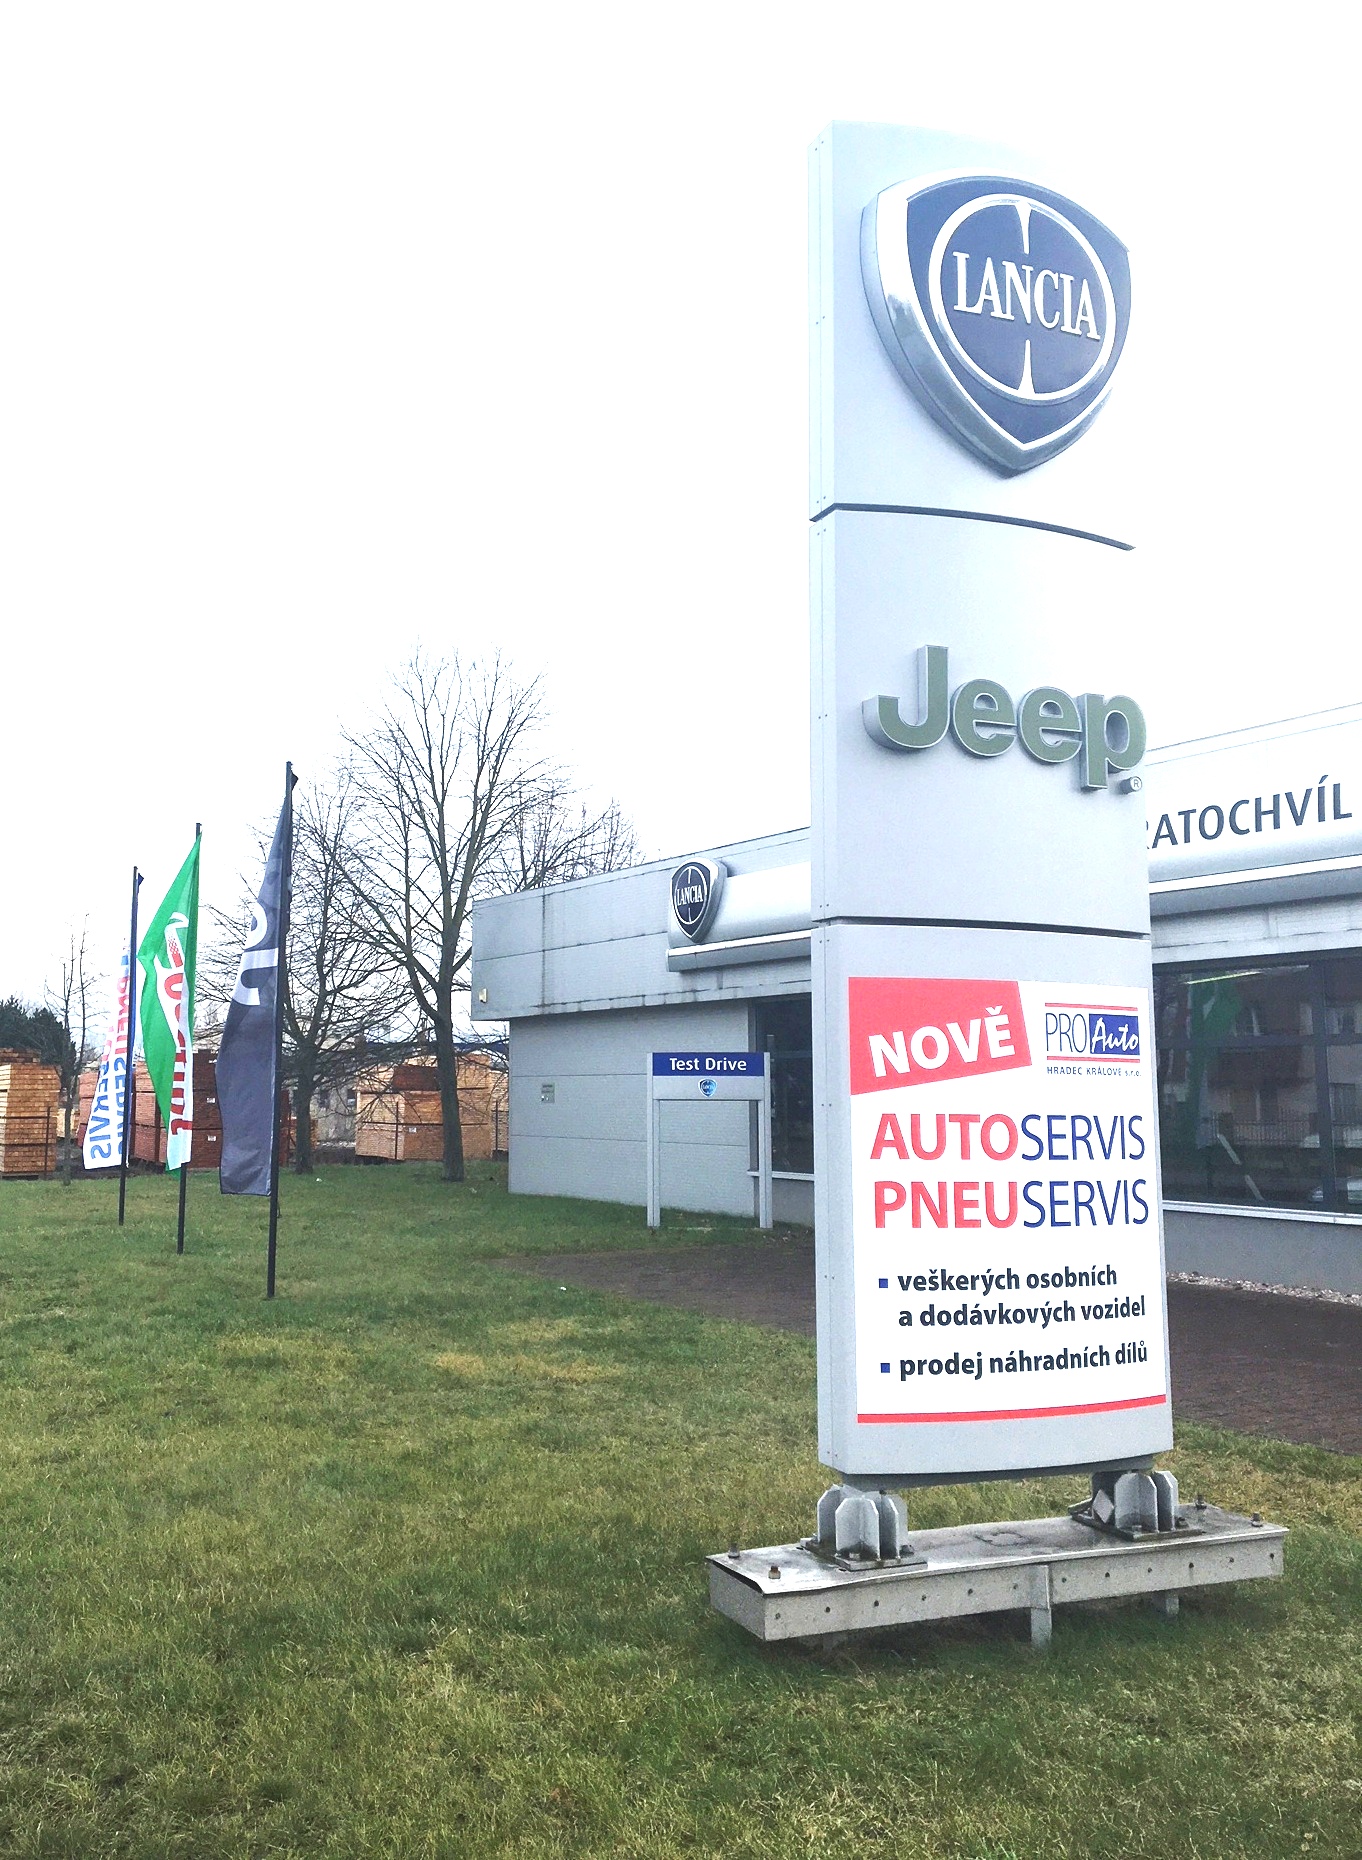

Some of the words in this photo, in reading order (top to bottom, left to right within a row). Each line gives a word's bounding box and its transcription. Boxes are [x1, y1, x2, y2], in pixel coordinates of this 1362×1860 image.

[953, 250, 1101, 341] LANCIA
[862, 645, 1147, 791] Jeep
[1145, 775, 1353, 850] ATOCHVÍL
[676, 883, 704, 906] LANCIA
[868, 1005, 1015, 1078] NOVĚ
[1045, 1012, 1087, 1053] PRO
[669, 1057, 700, 1072] Test
[705, 1057, 747, 1072] Drive
[1046, 1066, 1083, 1076] HRADEC
[869, 1113, 1146, 1161] AUTOSERVIS
[874, 1179, 1150, 1229] PNEUSERVIS
[897, 1268, 1020, 1297] veškerých
[1025, 1264, 1118, 1291] osobních
[898, 1313, 913, 1327] a
[919, 1301, 1077, 1329] dodávkových
[1080, 1295, 1146, 1320] vozidel
[899, 1351, 984, 1381] prodej
[988, 1345, 1111, 1374] náhradních
[1114, 1340, 1148, 1366] dílů
